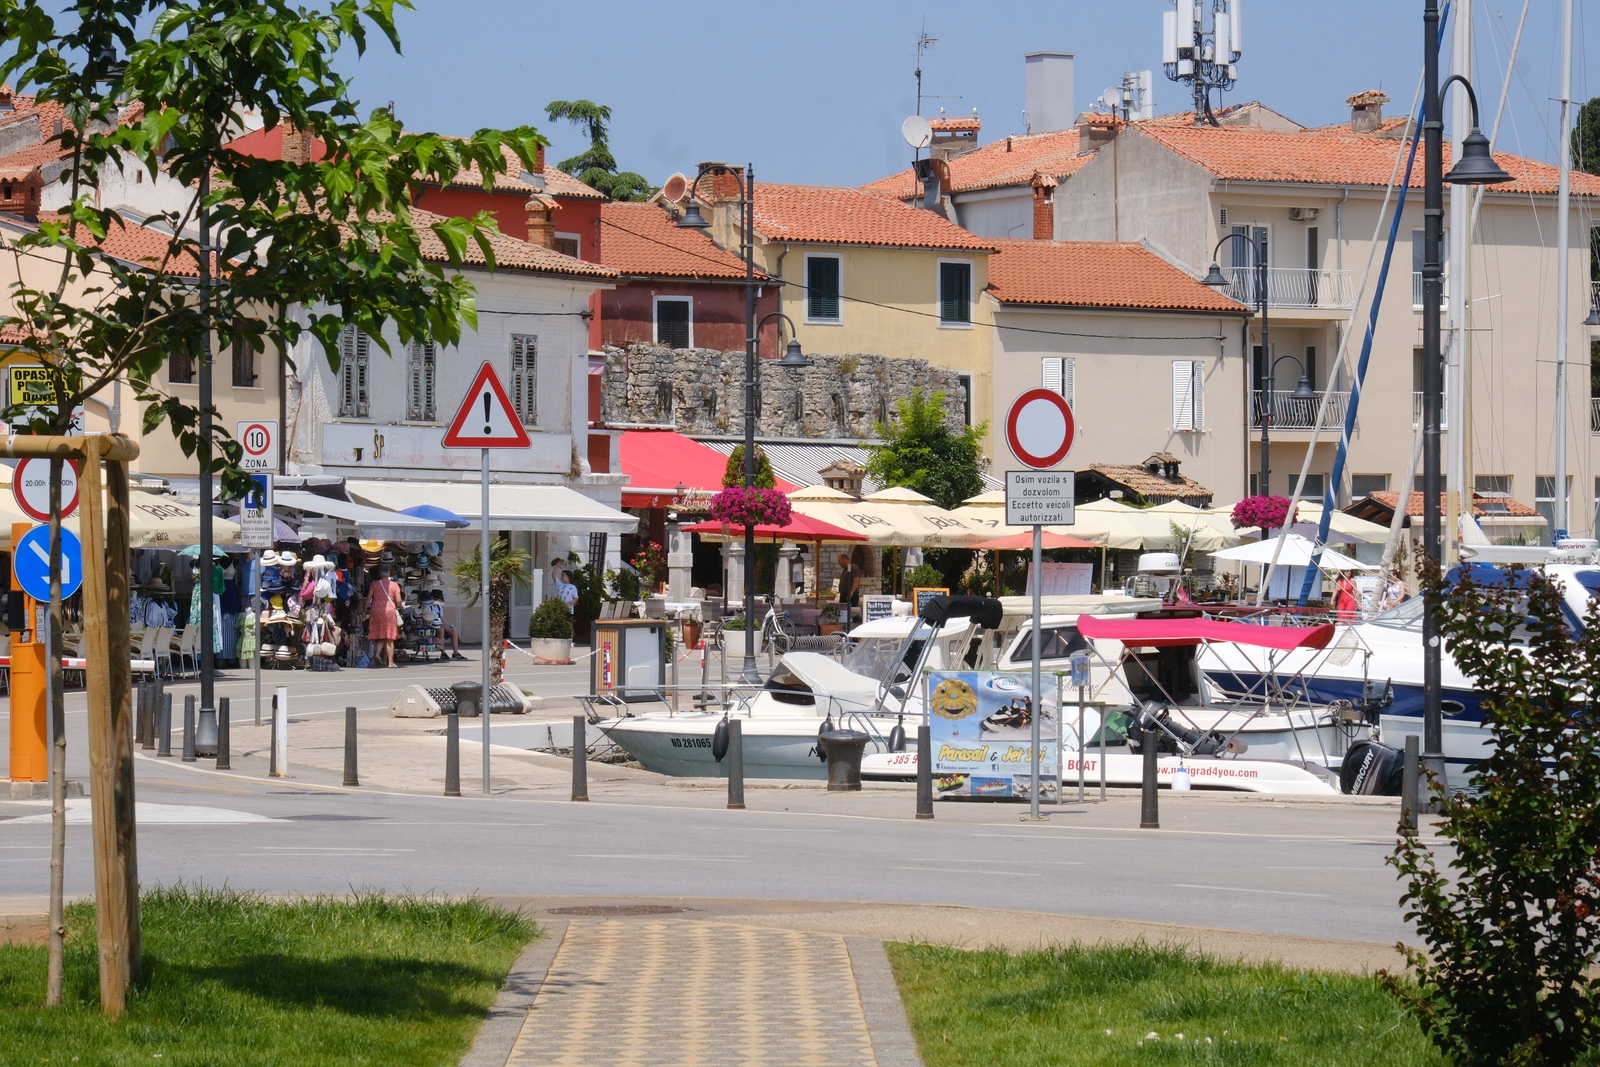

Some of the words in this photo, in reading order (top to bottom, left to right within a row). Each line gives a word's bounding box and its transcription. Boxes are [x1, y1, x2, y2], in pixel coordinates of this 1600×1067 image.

[23, 392, 70, 402] DANGR
[250, 431, 263, 448] 10
[245, 459, 267, 468] ZONA
[1015, 474, 1035, 484] Osim
[1037, 474, 1060, 484] vozila
[1062, 476, 1067, 484] s
[1022, 487, 1060, 496] dozvolom
[1012, 500, 1043, 509] Eccetto
[1046, 500, 1071, 509] veicoli
[1020, 512, 1063, 521] autorizzati
[671, 738, 682, 747] ND
[683, 738, 711, 748] 281065
[938, 745, 989, 761] Parasail
[990, 751, 998, 761] &
[1001, 745, 1025, 762] Jet
[1025, 746, 1047, 762] Si
[886, 754, 911, 765] +385
[1350, 748, 1374, 795] MERCURY
